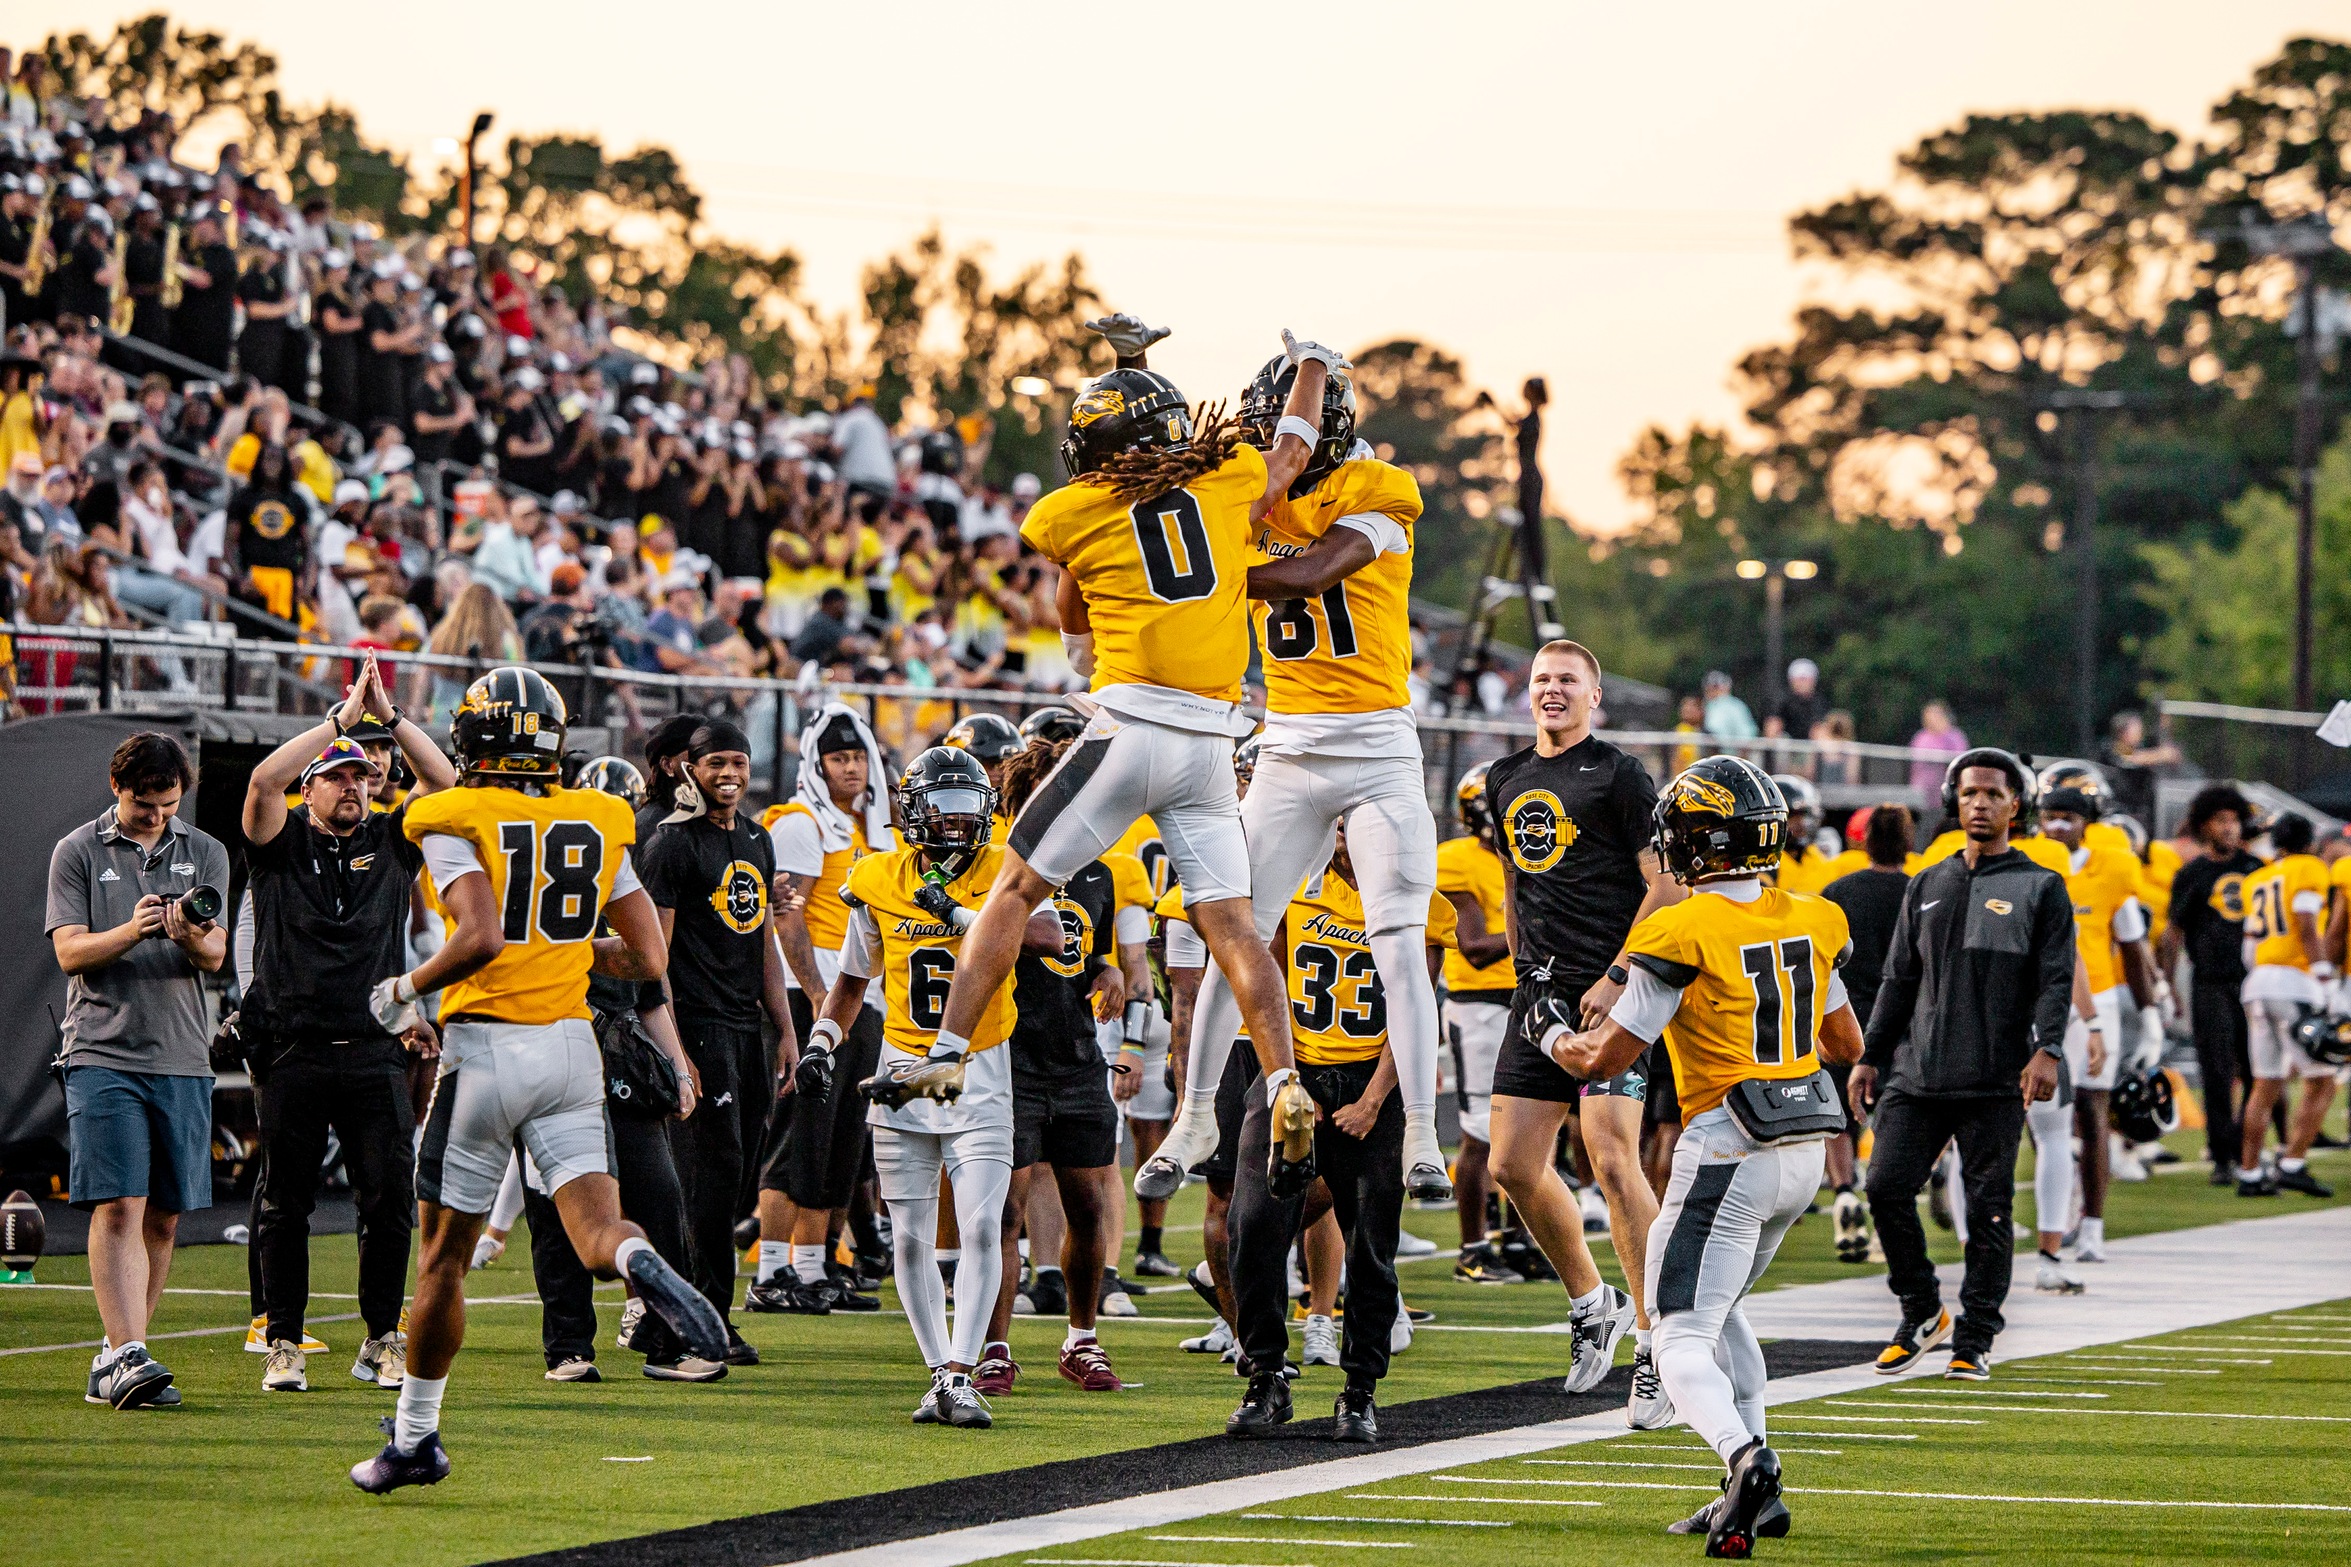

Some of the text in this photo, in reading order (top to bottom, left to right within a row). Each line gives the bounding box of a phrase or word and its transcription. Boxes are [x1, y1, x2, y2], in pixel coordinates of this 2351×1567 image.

[1168, 418, 1181, 441] 0
[1128, 485, 1218, 604] 0
[1256, 529, 1317, 560] Apac
[511, 712, 540, 735] 18
[498, 757, 521, 772] Rose
[1525, 792, 1549, 801] ROSE CITY
[1758, 821, 1779, 847] 11
[497, 820, 604, 944] 18
[2252, 880, 2286, 938] 31
[894, 917, 967, 941] Apache
[1301, 912, 1371, 947] Apach
[908, 946, 957, 1031] 6
[1291, 941, 1388, 1038] 33
[1739, 935, 1816, 1066] 11
